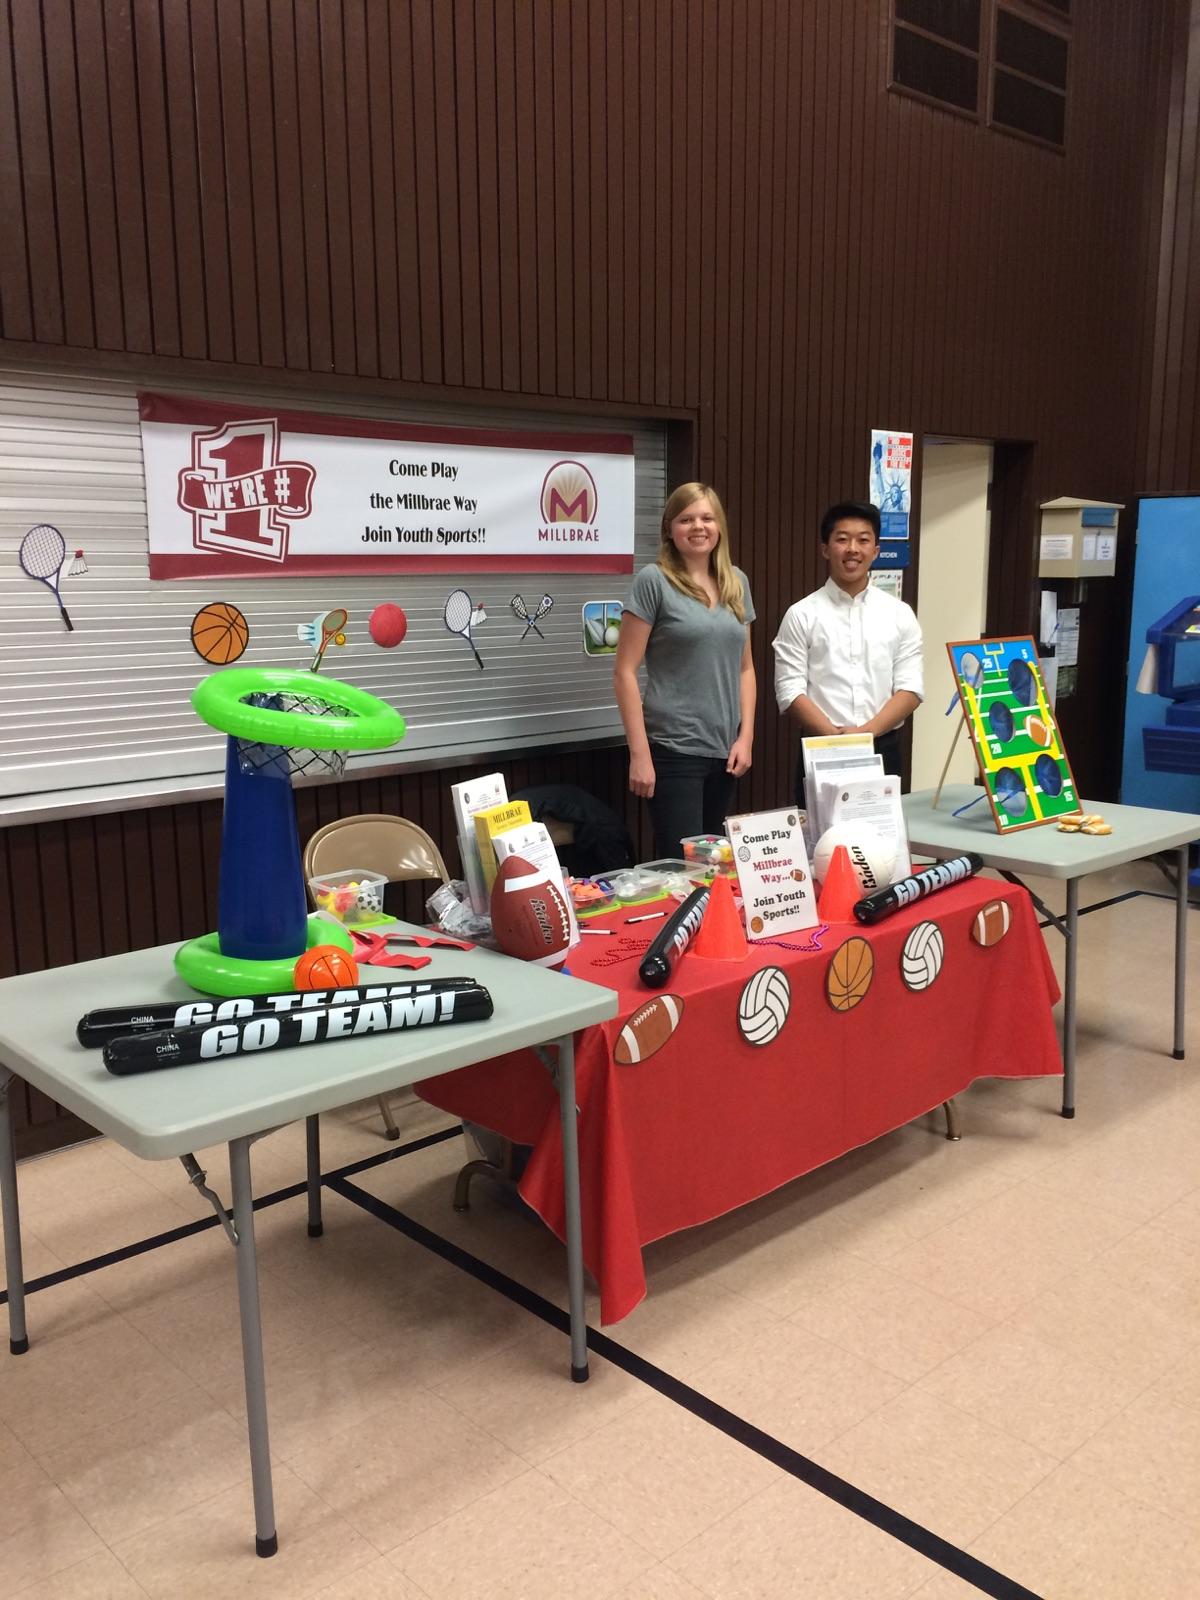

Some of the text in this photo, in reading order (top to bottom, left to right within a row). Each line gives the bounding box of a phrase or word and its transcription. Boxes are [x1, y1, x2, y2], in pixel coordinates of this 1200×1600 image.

[388, 459, 459, 482] Come Play
[203, 469, 290, 509] WE'RE #
[369, 492, 478, 515] the Millbrae Way
[361, 525, 486, 546] Join Youth Sports!!
[538, 527, 600, 542] MILLBRAE
[1021, 648, 1029, 659] 5
[981, 657, 993, 669] 25
[492, 806, 523, 824] MILLBRAE
[742, 829, 792, 844] Come Play
[762, 846, 779, 856] the
[752, 858, 793, 872] Millbrae
[760, 873, 791, 884] Way...
[894, 856, 972, 908] GO TEAM!
[753, 889, 806, 908] Join Youth
[762, 904, 800, 921] Sports!!
[130, 1015, 154, 1024] CHINA
[200, 990, 456, 1059] GO TEAM!
[155, 1043, 180, 1054] CHINA
